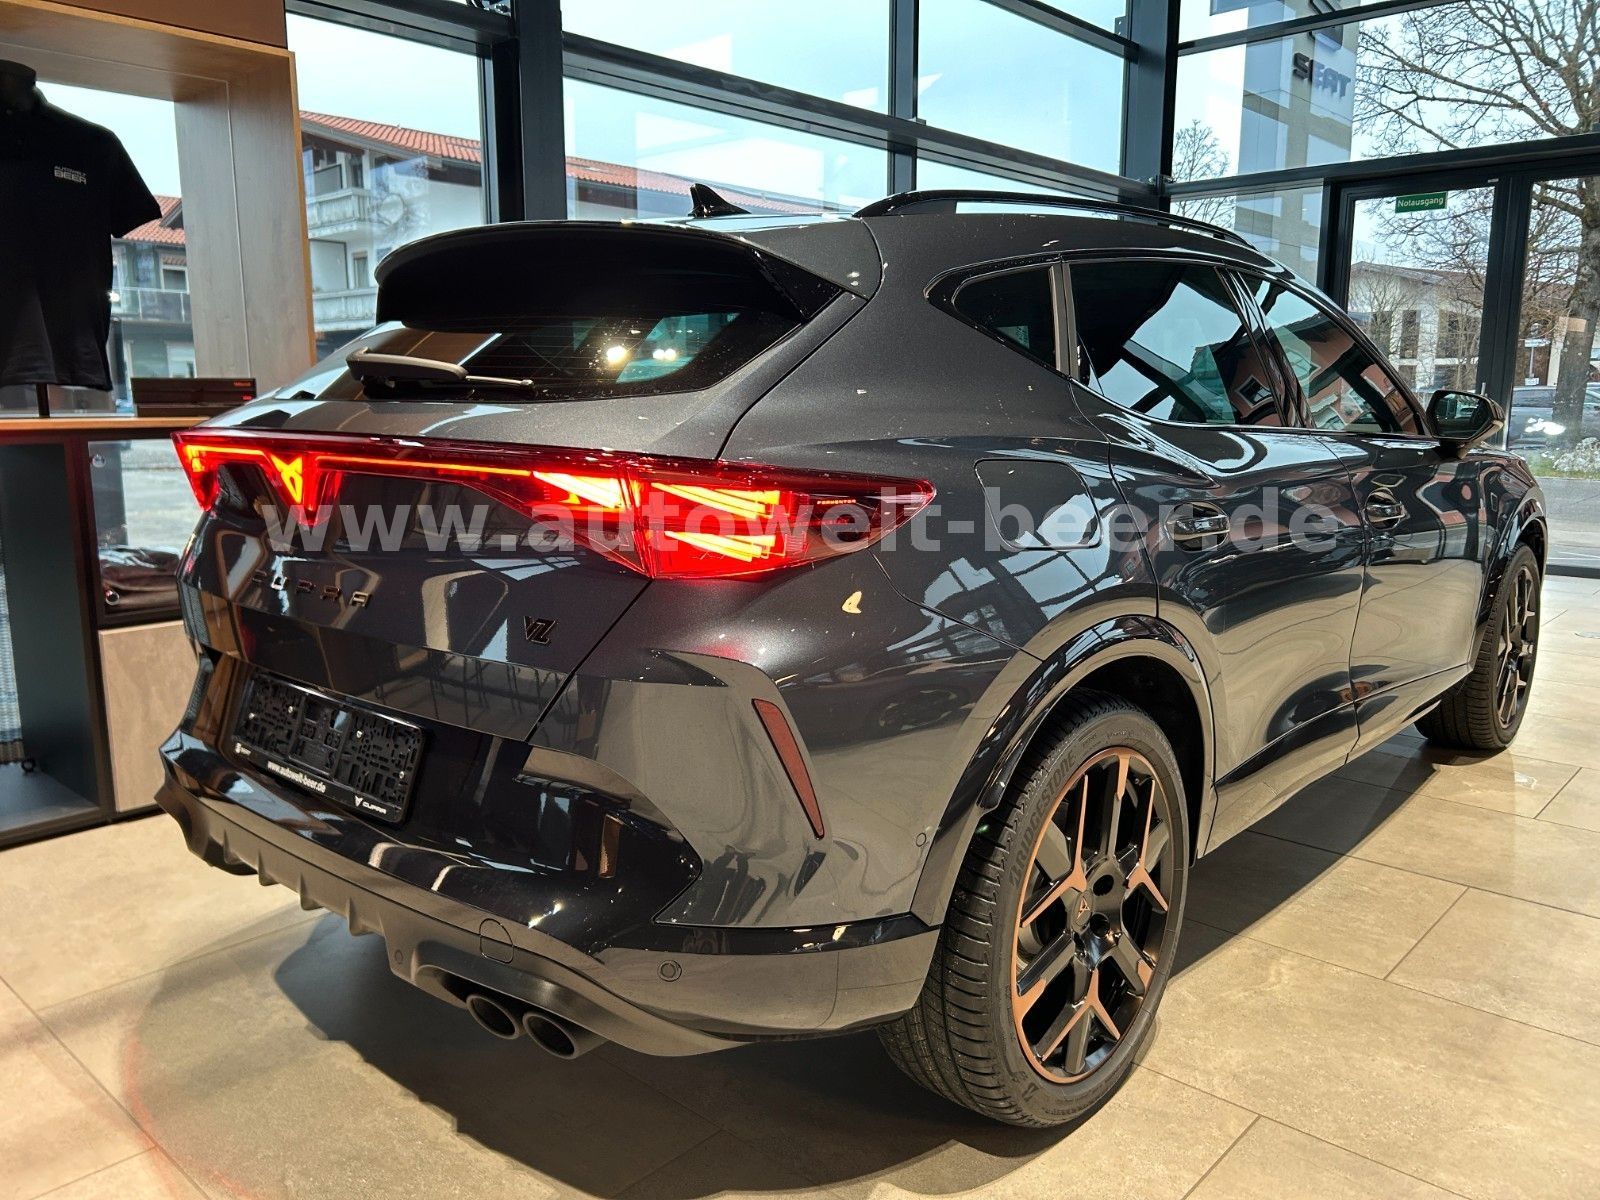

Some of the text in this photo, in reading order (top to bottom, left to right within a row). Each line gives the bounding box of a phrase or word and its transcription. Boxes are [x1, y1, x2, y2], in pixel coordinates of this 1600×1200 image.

[1292, 52, 1351, 97] SEAT
[54, 169, 87, 185] BEER
[1397, 197, 1444, 207] Notausgang
[523, 615, 556, 646] VZ
[362, 801, 387, 815] CUPRA
[1008, 750, 1077, 887] BRIDGESTONE
